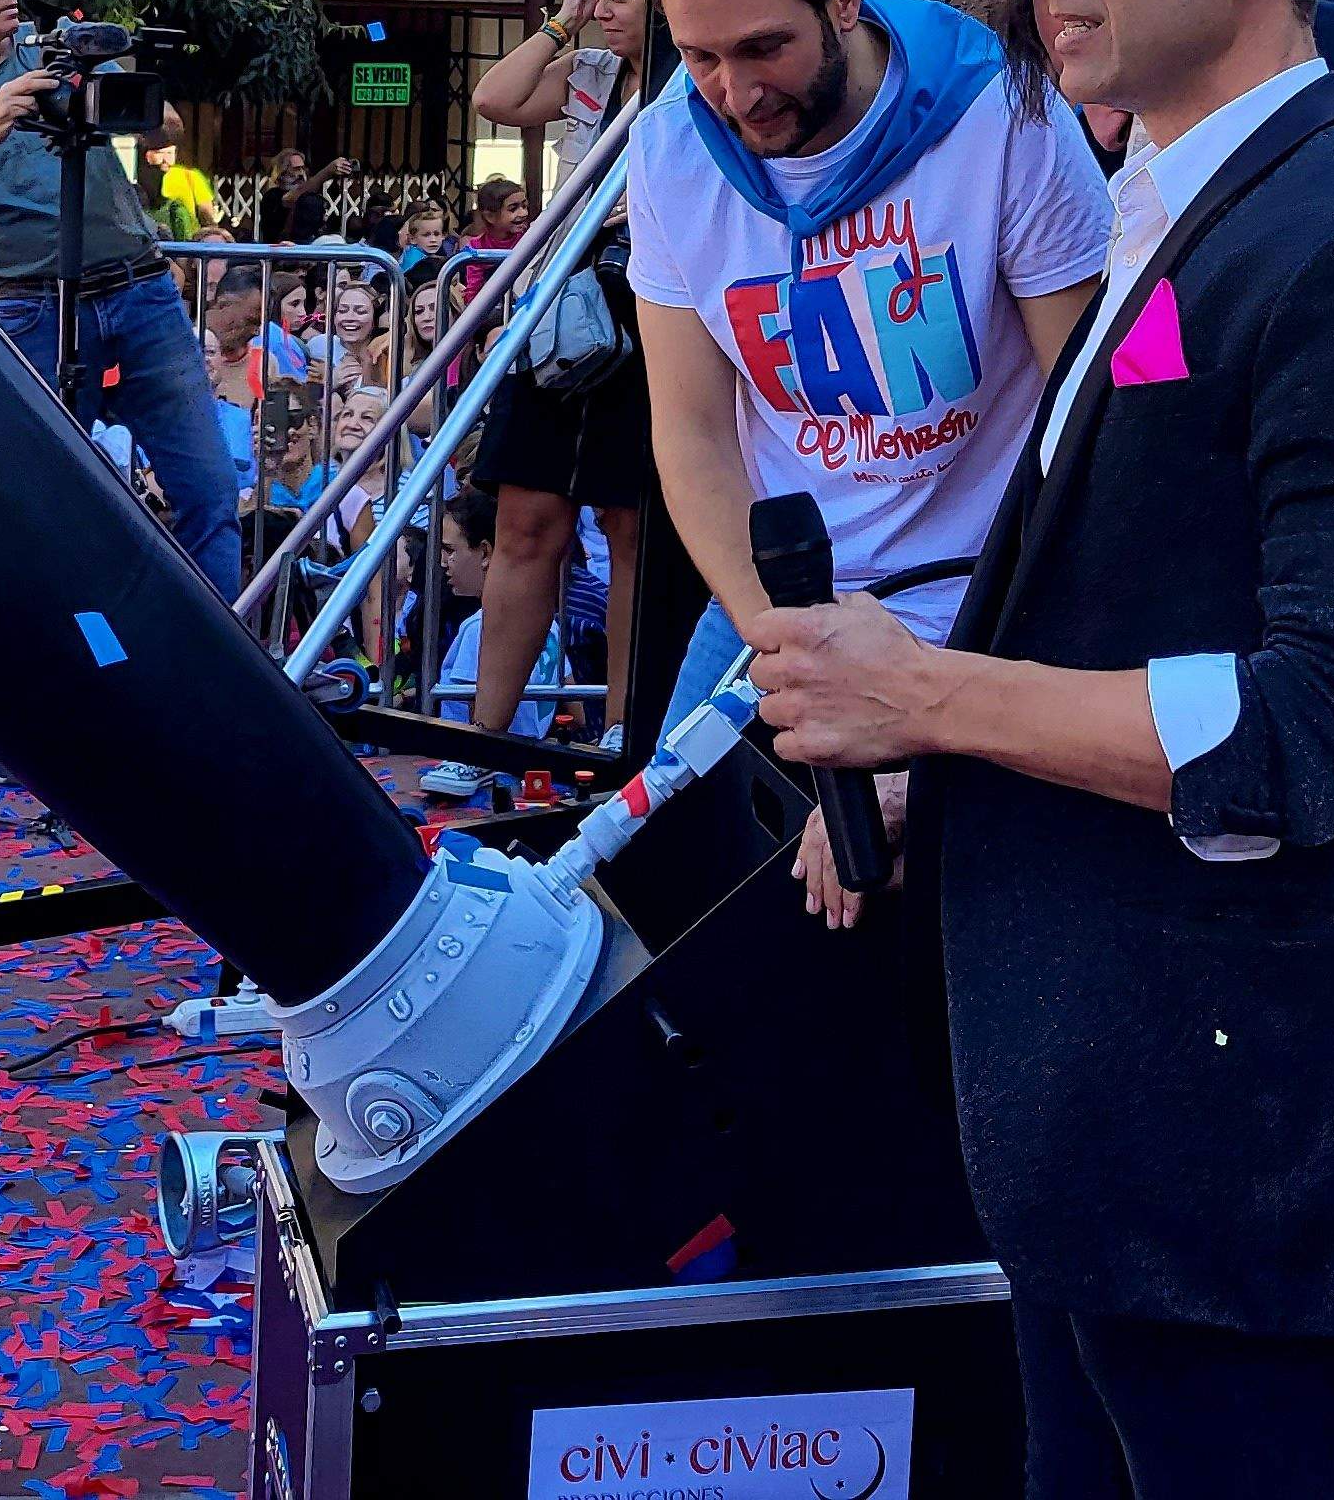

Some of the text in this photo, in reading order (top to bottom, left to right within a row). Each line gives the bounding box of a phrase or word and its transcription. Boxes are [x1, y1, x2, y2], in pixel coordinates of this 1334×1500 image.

[355, 66, 409, 84] SE VENDE
[723, 241, 984, 418] FAN
[794, 388, 848, 471] de
[559, 1422, 842, 1484] civi civiac
